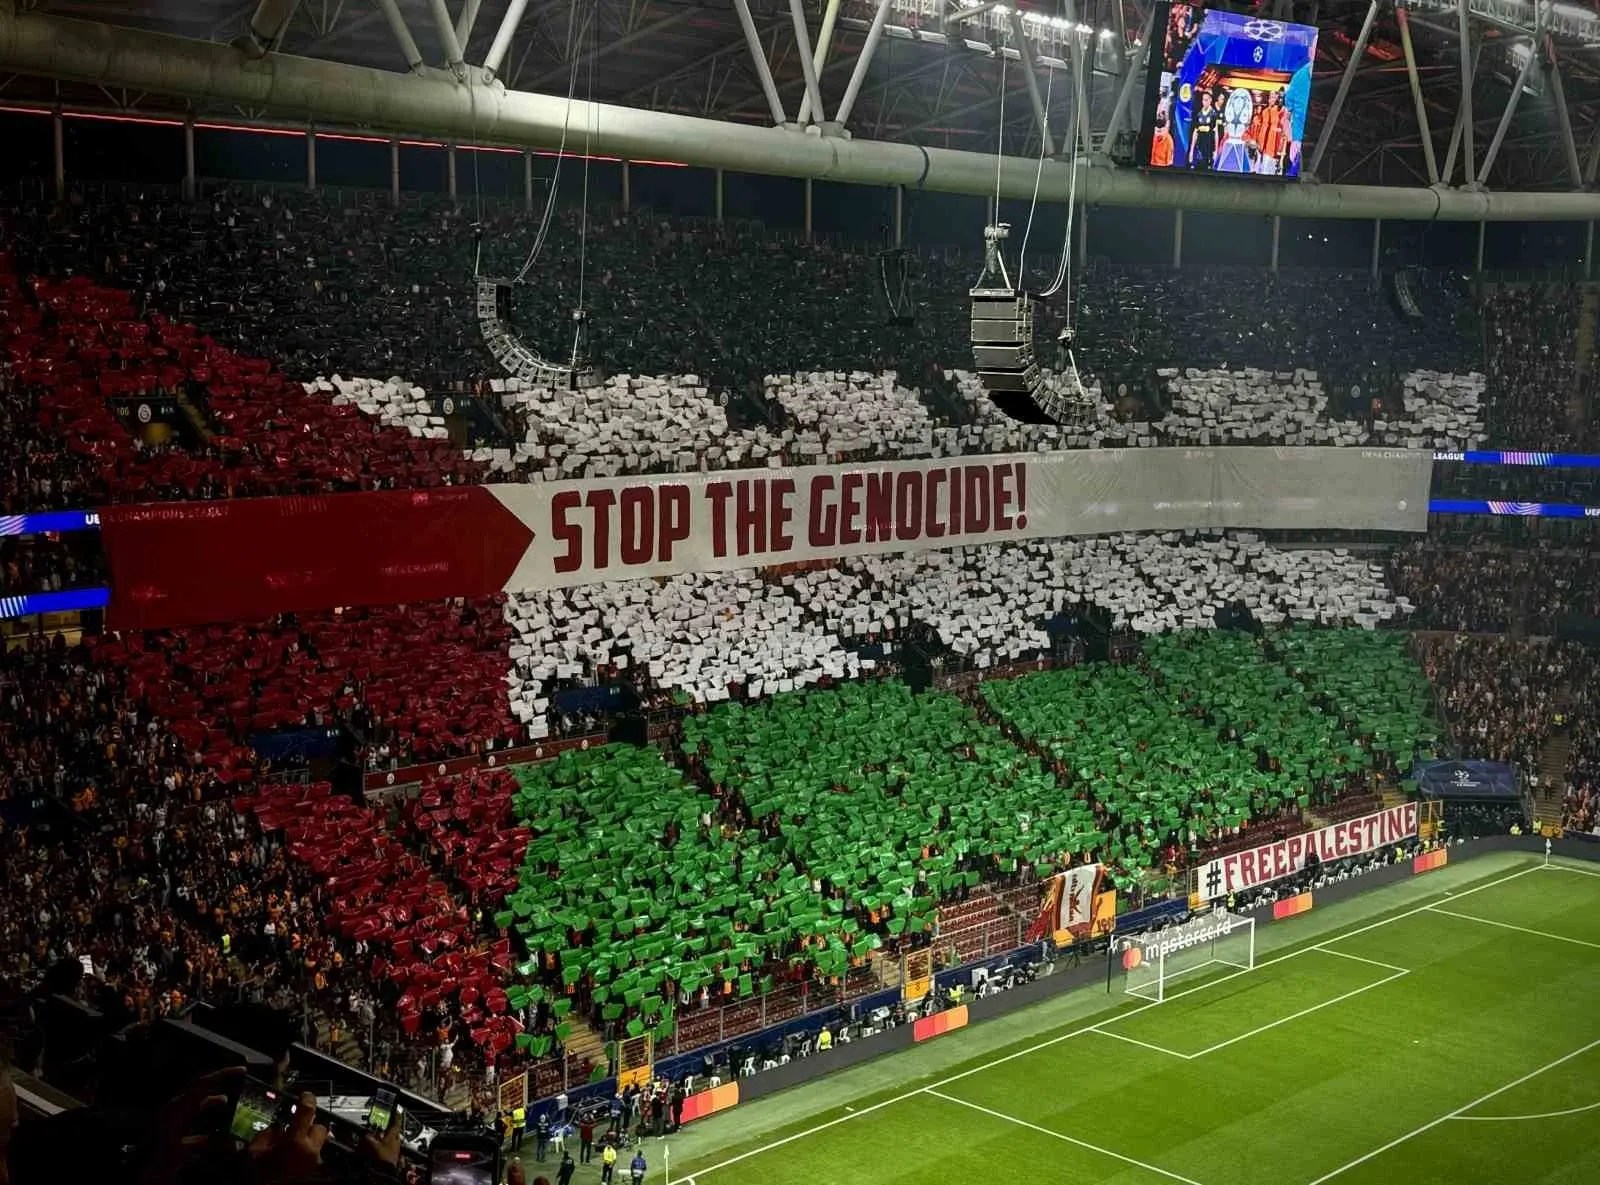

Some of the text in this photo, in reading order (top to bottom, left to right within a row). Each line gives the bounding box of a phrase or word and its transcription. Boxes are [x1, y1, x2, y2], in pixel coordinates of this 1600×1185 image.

[1432, 451, 1465, 461] LEAGUE
[551, 462, 1028, 573] STOP THE GENOCIDE!
[1206, 803, 1418, 898] #FREEPALESTINE
[1145, 917, 1232, 961] mastercard
